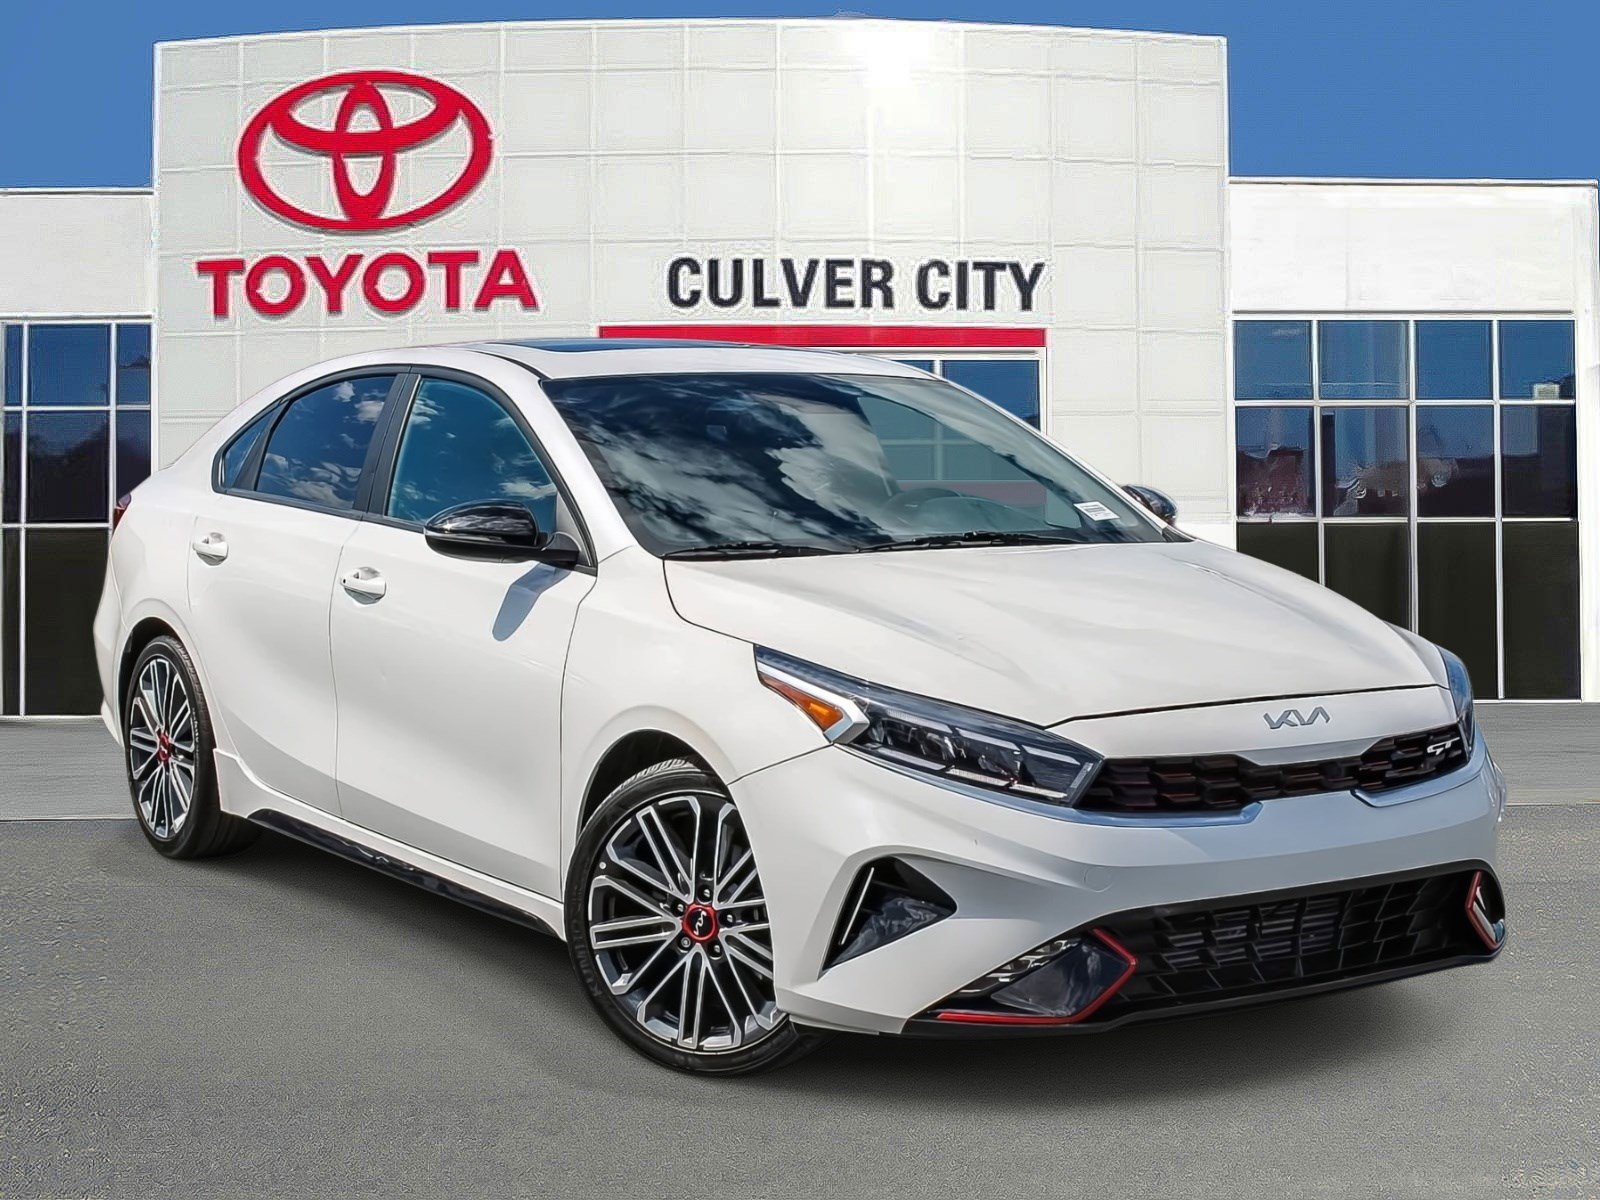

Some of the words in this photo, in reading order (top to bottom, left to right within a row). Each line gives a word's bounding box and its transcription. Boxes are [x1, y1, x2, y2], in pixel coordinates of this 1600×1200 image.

[196, 249, 540, 319] TOYOTA
[668, 257, 895, 309] CULVER
[916, 259, 1046, 312] CITY
[1263, 706, 1331, 730] KIA
[1426, 736, 1461, 756] GT
